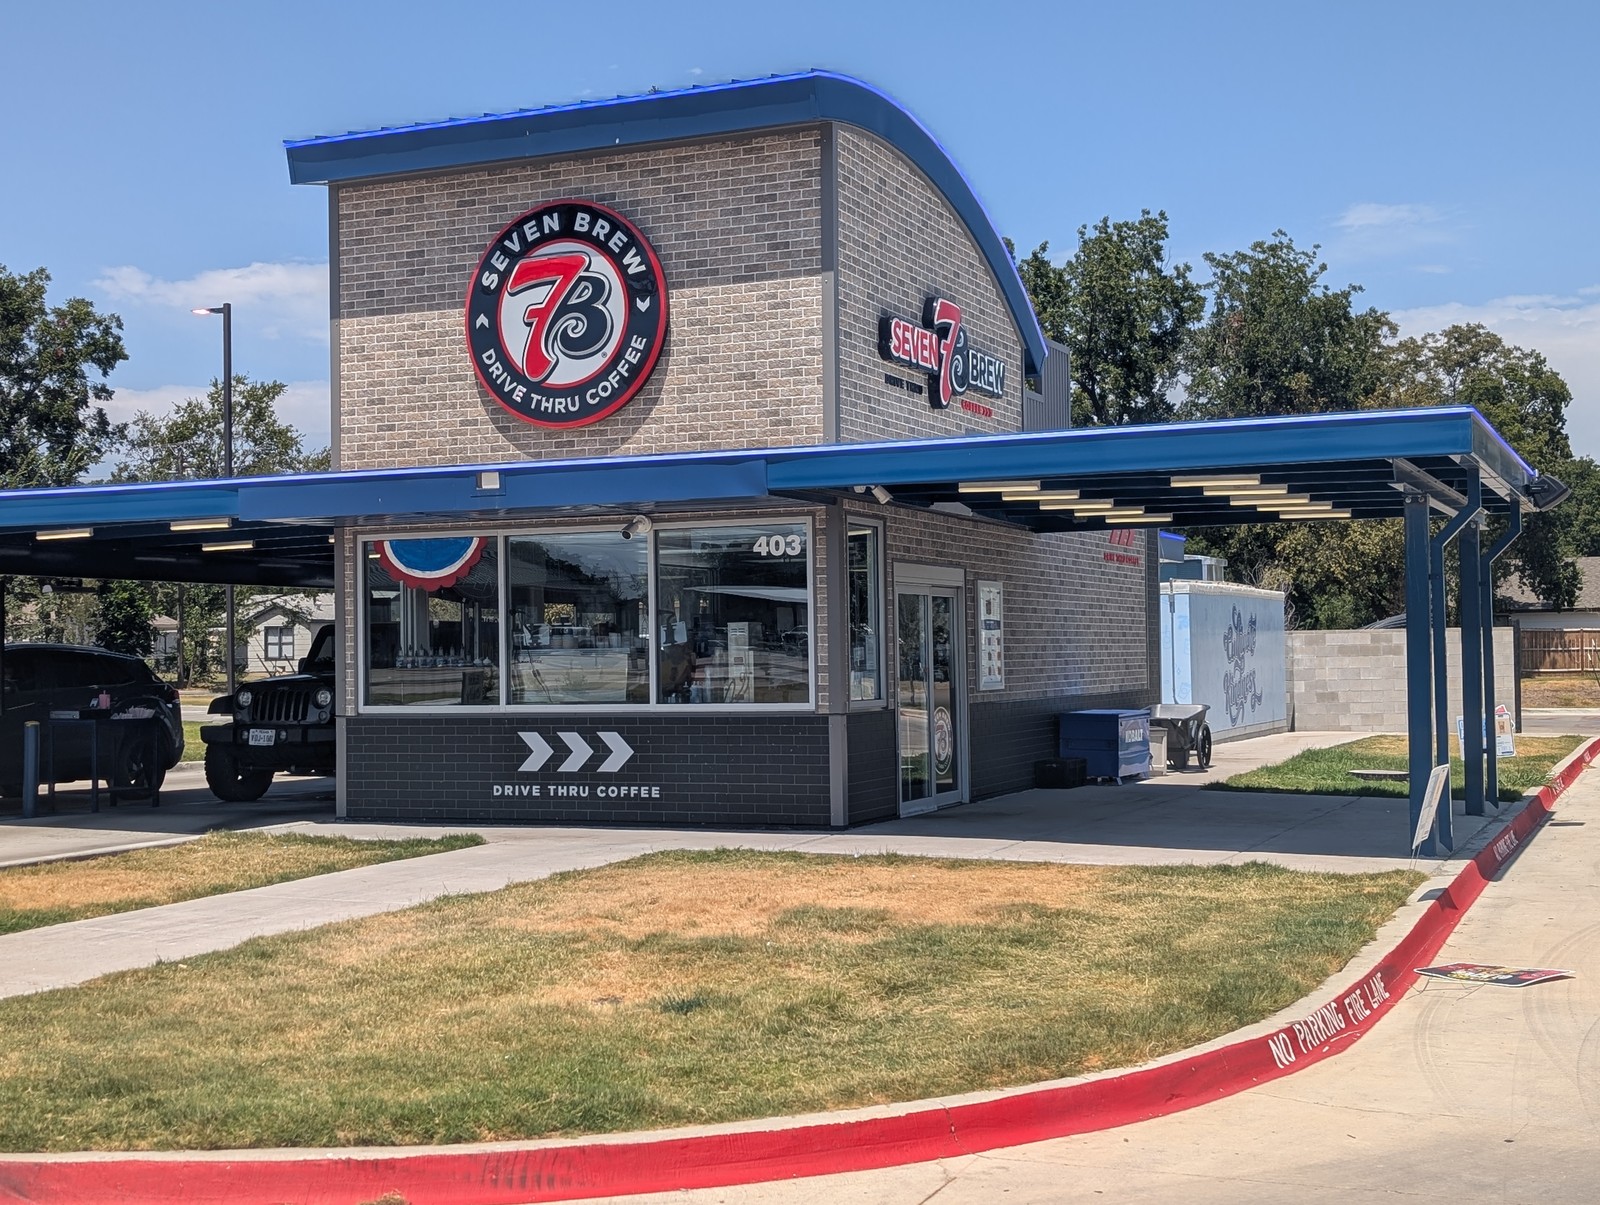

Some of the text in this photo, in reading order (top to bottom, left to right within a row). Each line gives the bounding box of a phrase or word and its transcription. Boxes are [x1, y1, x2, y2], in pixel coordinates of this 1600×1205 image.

[481, 211, 647, 290] SEVEN BREW
[481, 334, 647, 414] DRIVE THRU COFFEE
[890, 317, 939, 371] SEVEN
[968, 350, 1005, 395] BREW
[752, 534, 801, 556] 403
[493, 785, 661, 798] DRIVE THRU COFFEE
[1268, 1032, 1296, 1069] NO
[1292, 1001, 1346, 1054] PARKING
[1343, 988, 1371, 1025] FIRE
[1363, 972, 1390, 1009] LANE
